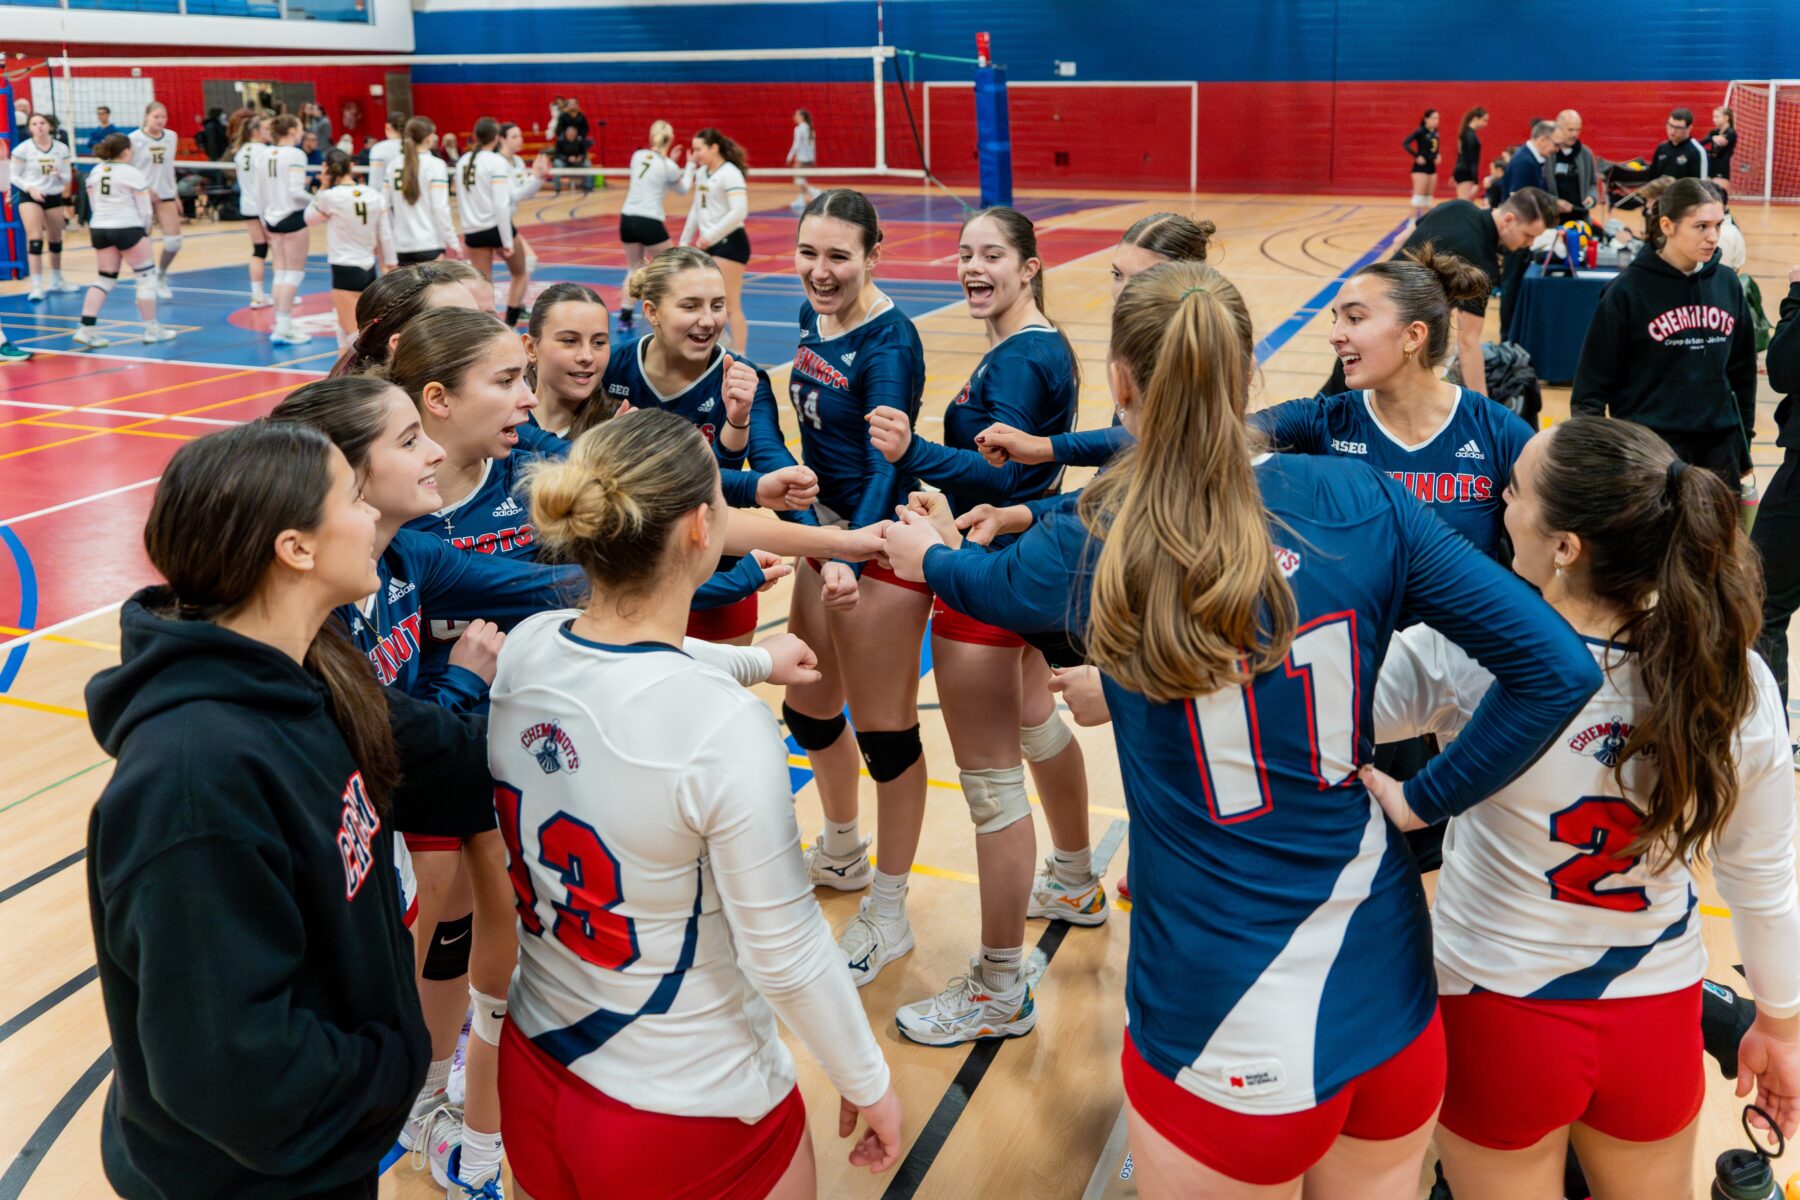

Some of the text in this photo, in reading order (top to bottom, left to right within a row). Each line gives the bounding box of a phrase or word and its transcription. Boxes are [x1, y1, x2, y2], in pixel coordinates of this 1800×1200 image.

[268, 158, 277, 178] 11
[638, 162, 650, 179] 7
[101, 176, 111, 195] 6
[354, 201, 367, 224] 4
[790, 382, 823, 431] 14
[1455, 451, 1485, 460] adidas
[1185, 608, 1362, 826] 11
[1544, 795, 1653, 913] 2
[493, 779, 642, 972] 13
